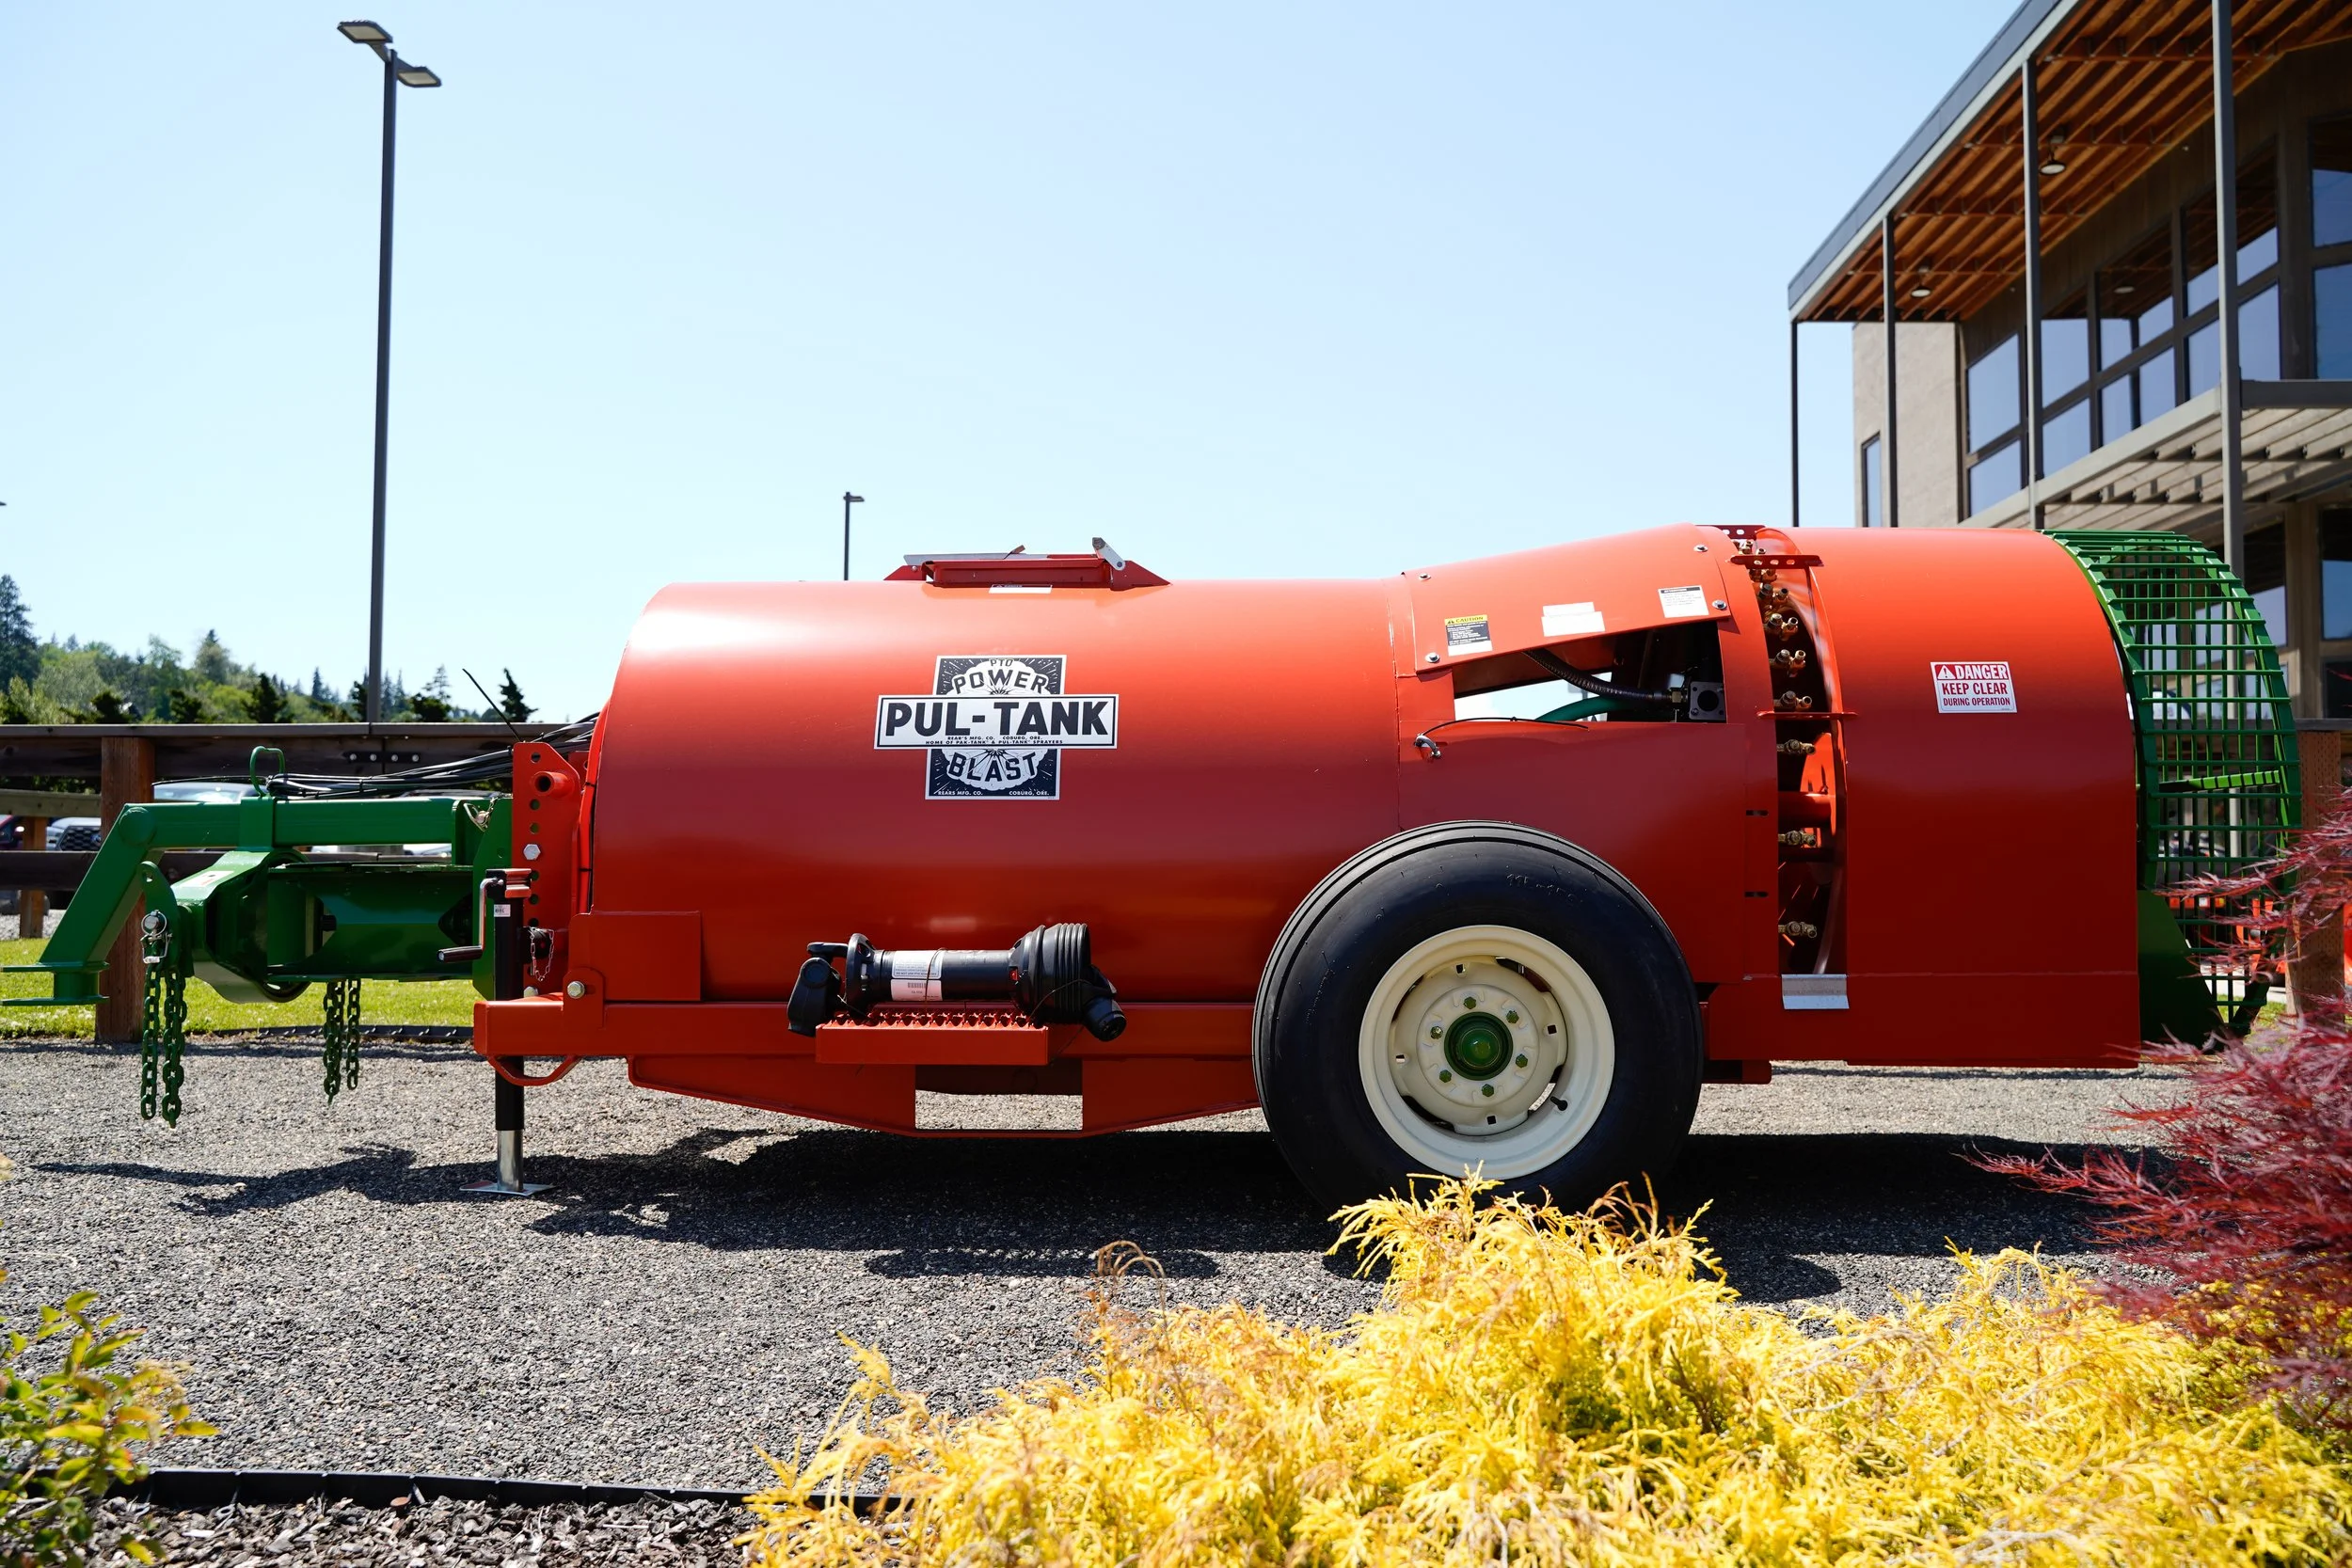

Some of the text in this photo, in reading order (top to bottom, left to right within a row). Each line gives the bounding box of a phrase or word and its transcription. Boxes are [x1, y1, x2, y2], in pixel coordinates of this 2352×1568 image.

[990, 658, 1013, 667] PTO
[1954, 664, 2008, 679] DANGER
[953, 669, 1047, 695] POWER
[1942, 683, 2008, 695] KEEP CLEAR
[1943, 697, 2010, 706] DURING OPERATION
[885, 701, 1109, 737] PUL-TANK
[948, 751, 1036, 783] BLAST
